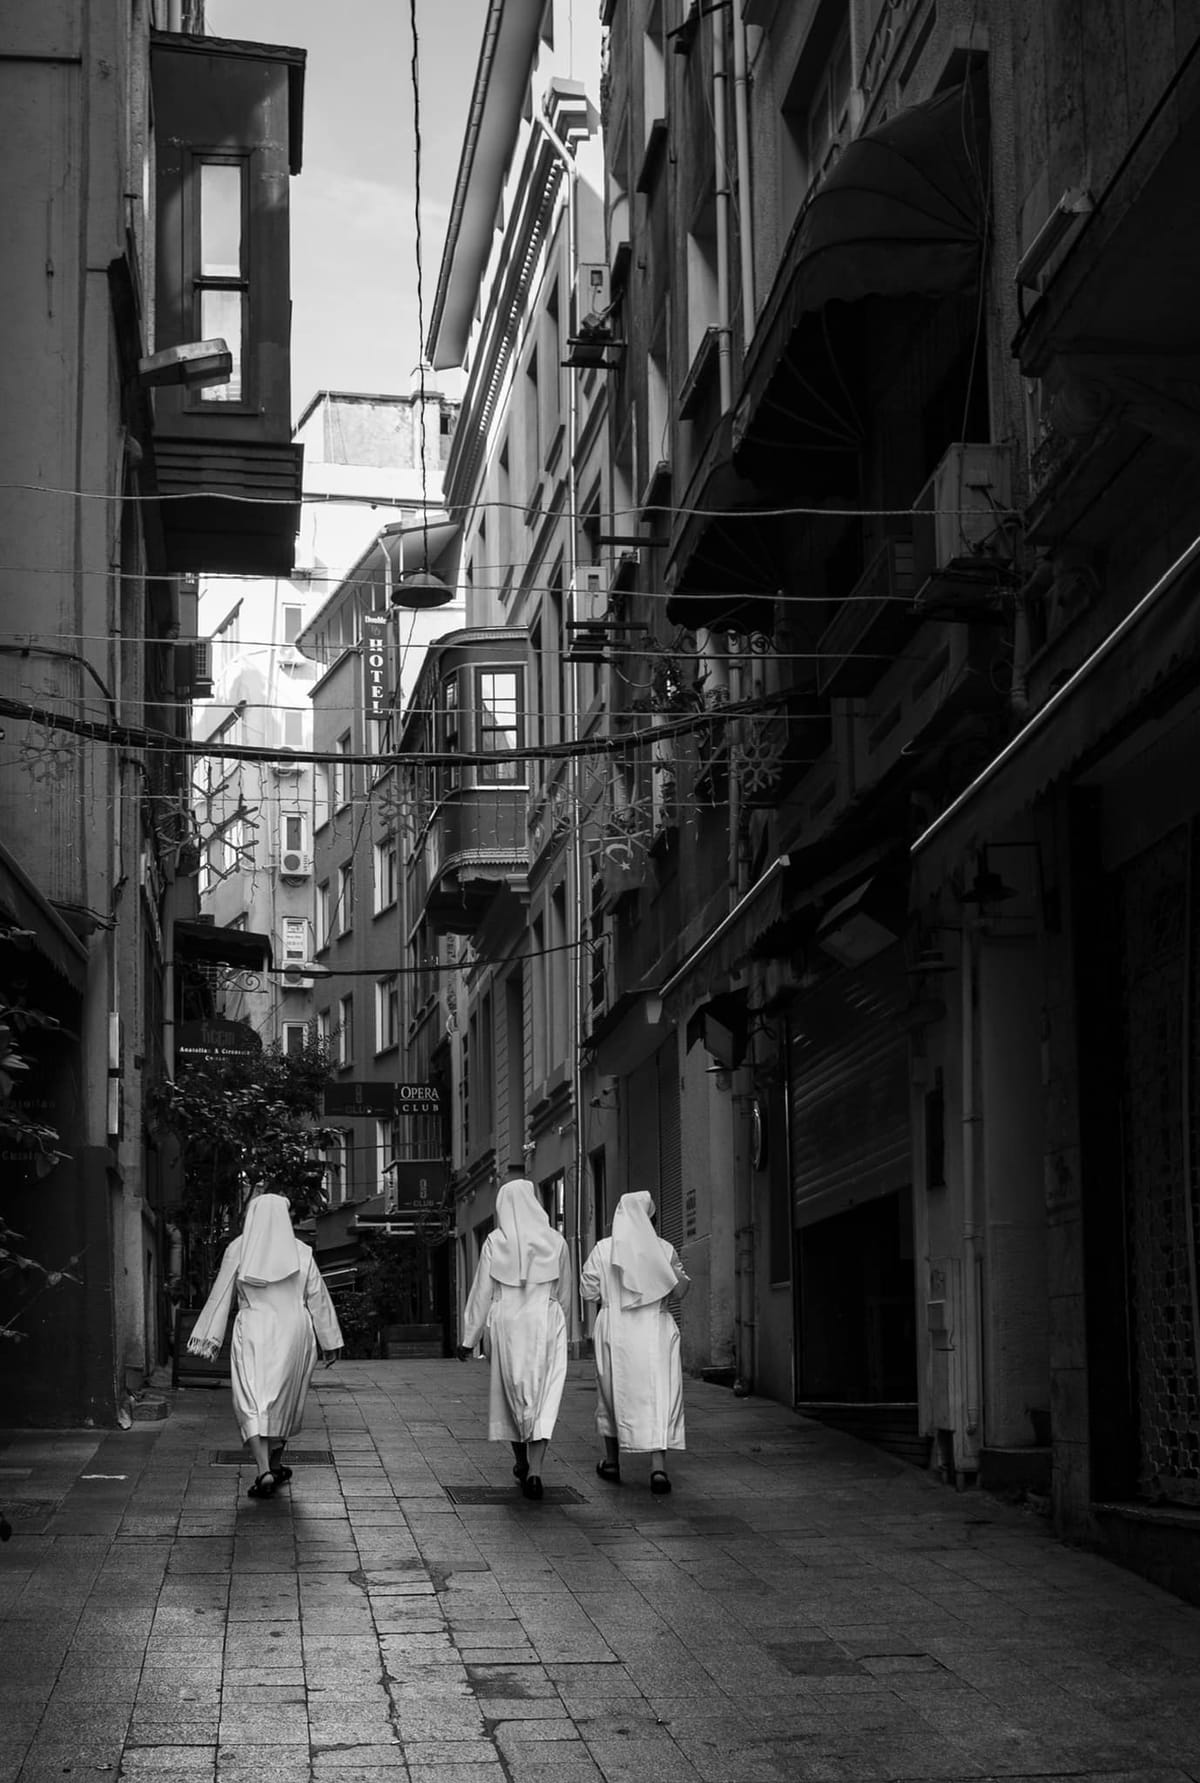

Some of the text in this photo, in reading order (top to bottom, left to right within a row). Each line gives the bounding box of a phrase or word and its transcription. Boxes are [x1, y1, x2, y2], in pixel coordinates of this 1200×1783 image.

[369, 638, 383, 714] HOTEL
[401, 1086, 439, 1101] OPERA
[402, 1104, 439, 1112] CLUB
